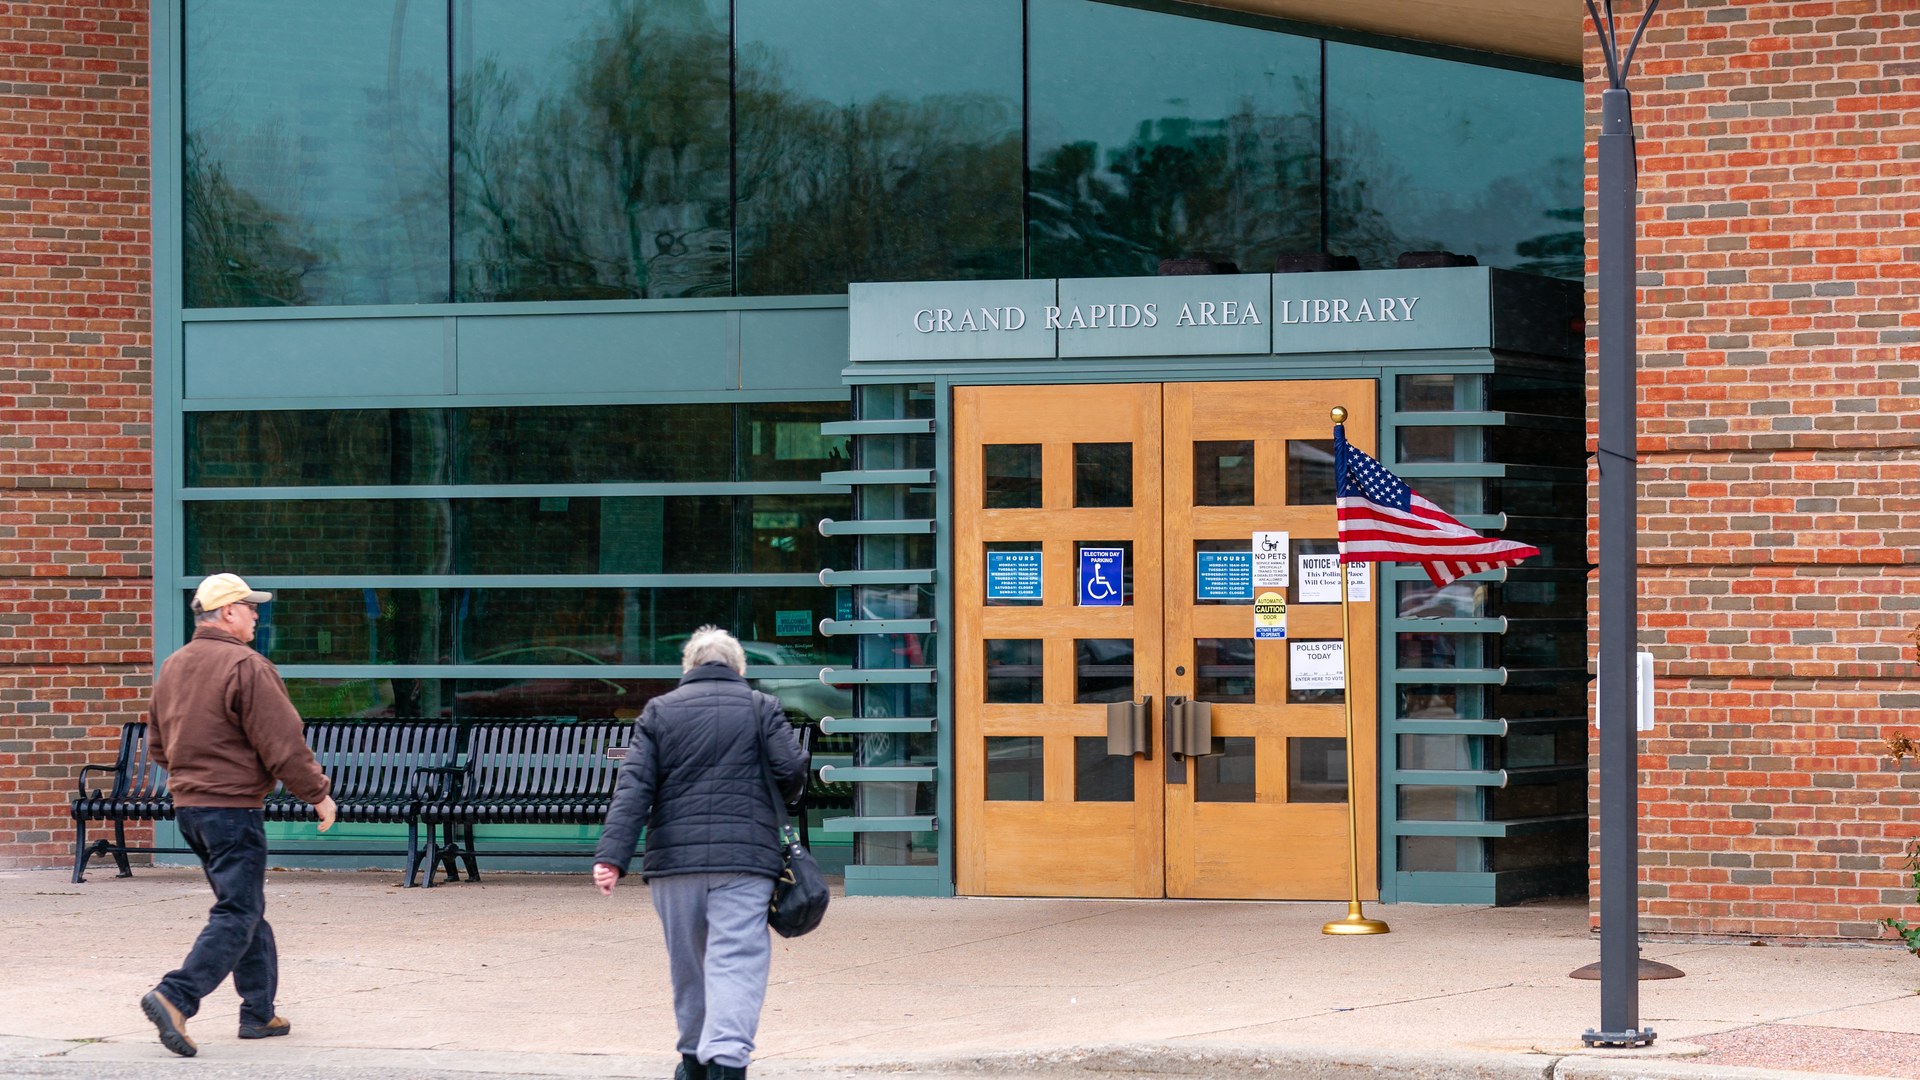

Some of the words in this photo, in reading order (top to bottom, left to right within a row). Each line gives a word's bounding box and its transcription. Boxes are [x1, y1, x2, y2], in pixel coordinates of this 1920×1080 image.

[914, 306, 1026, 332] GRAND
[1044, 304, 1158, 329] RAPIDS
[1176, 301, 1262, 326] AREA
[1281, 297, 1420, 324] LIBRARY
[1303, 559, 1330, 568] NOTICE
